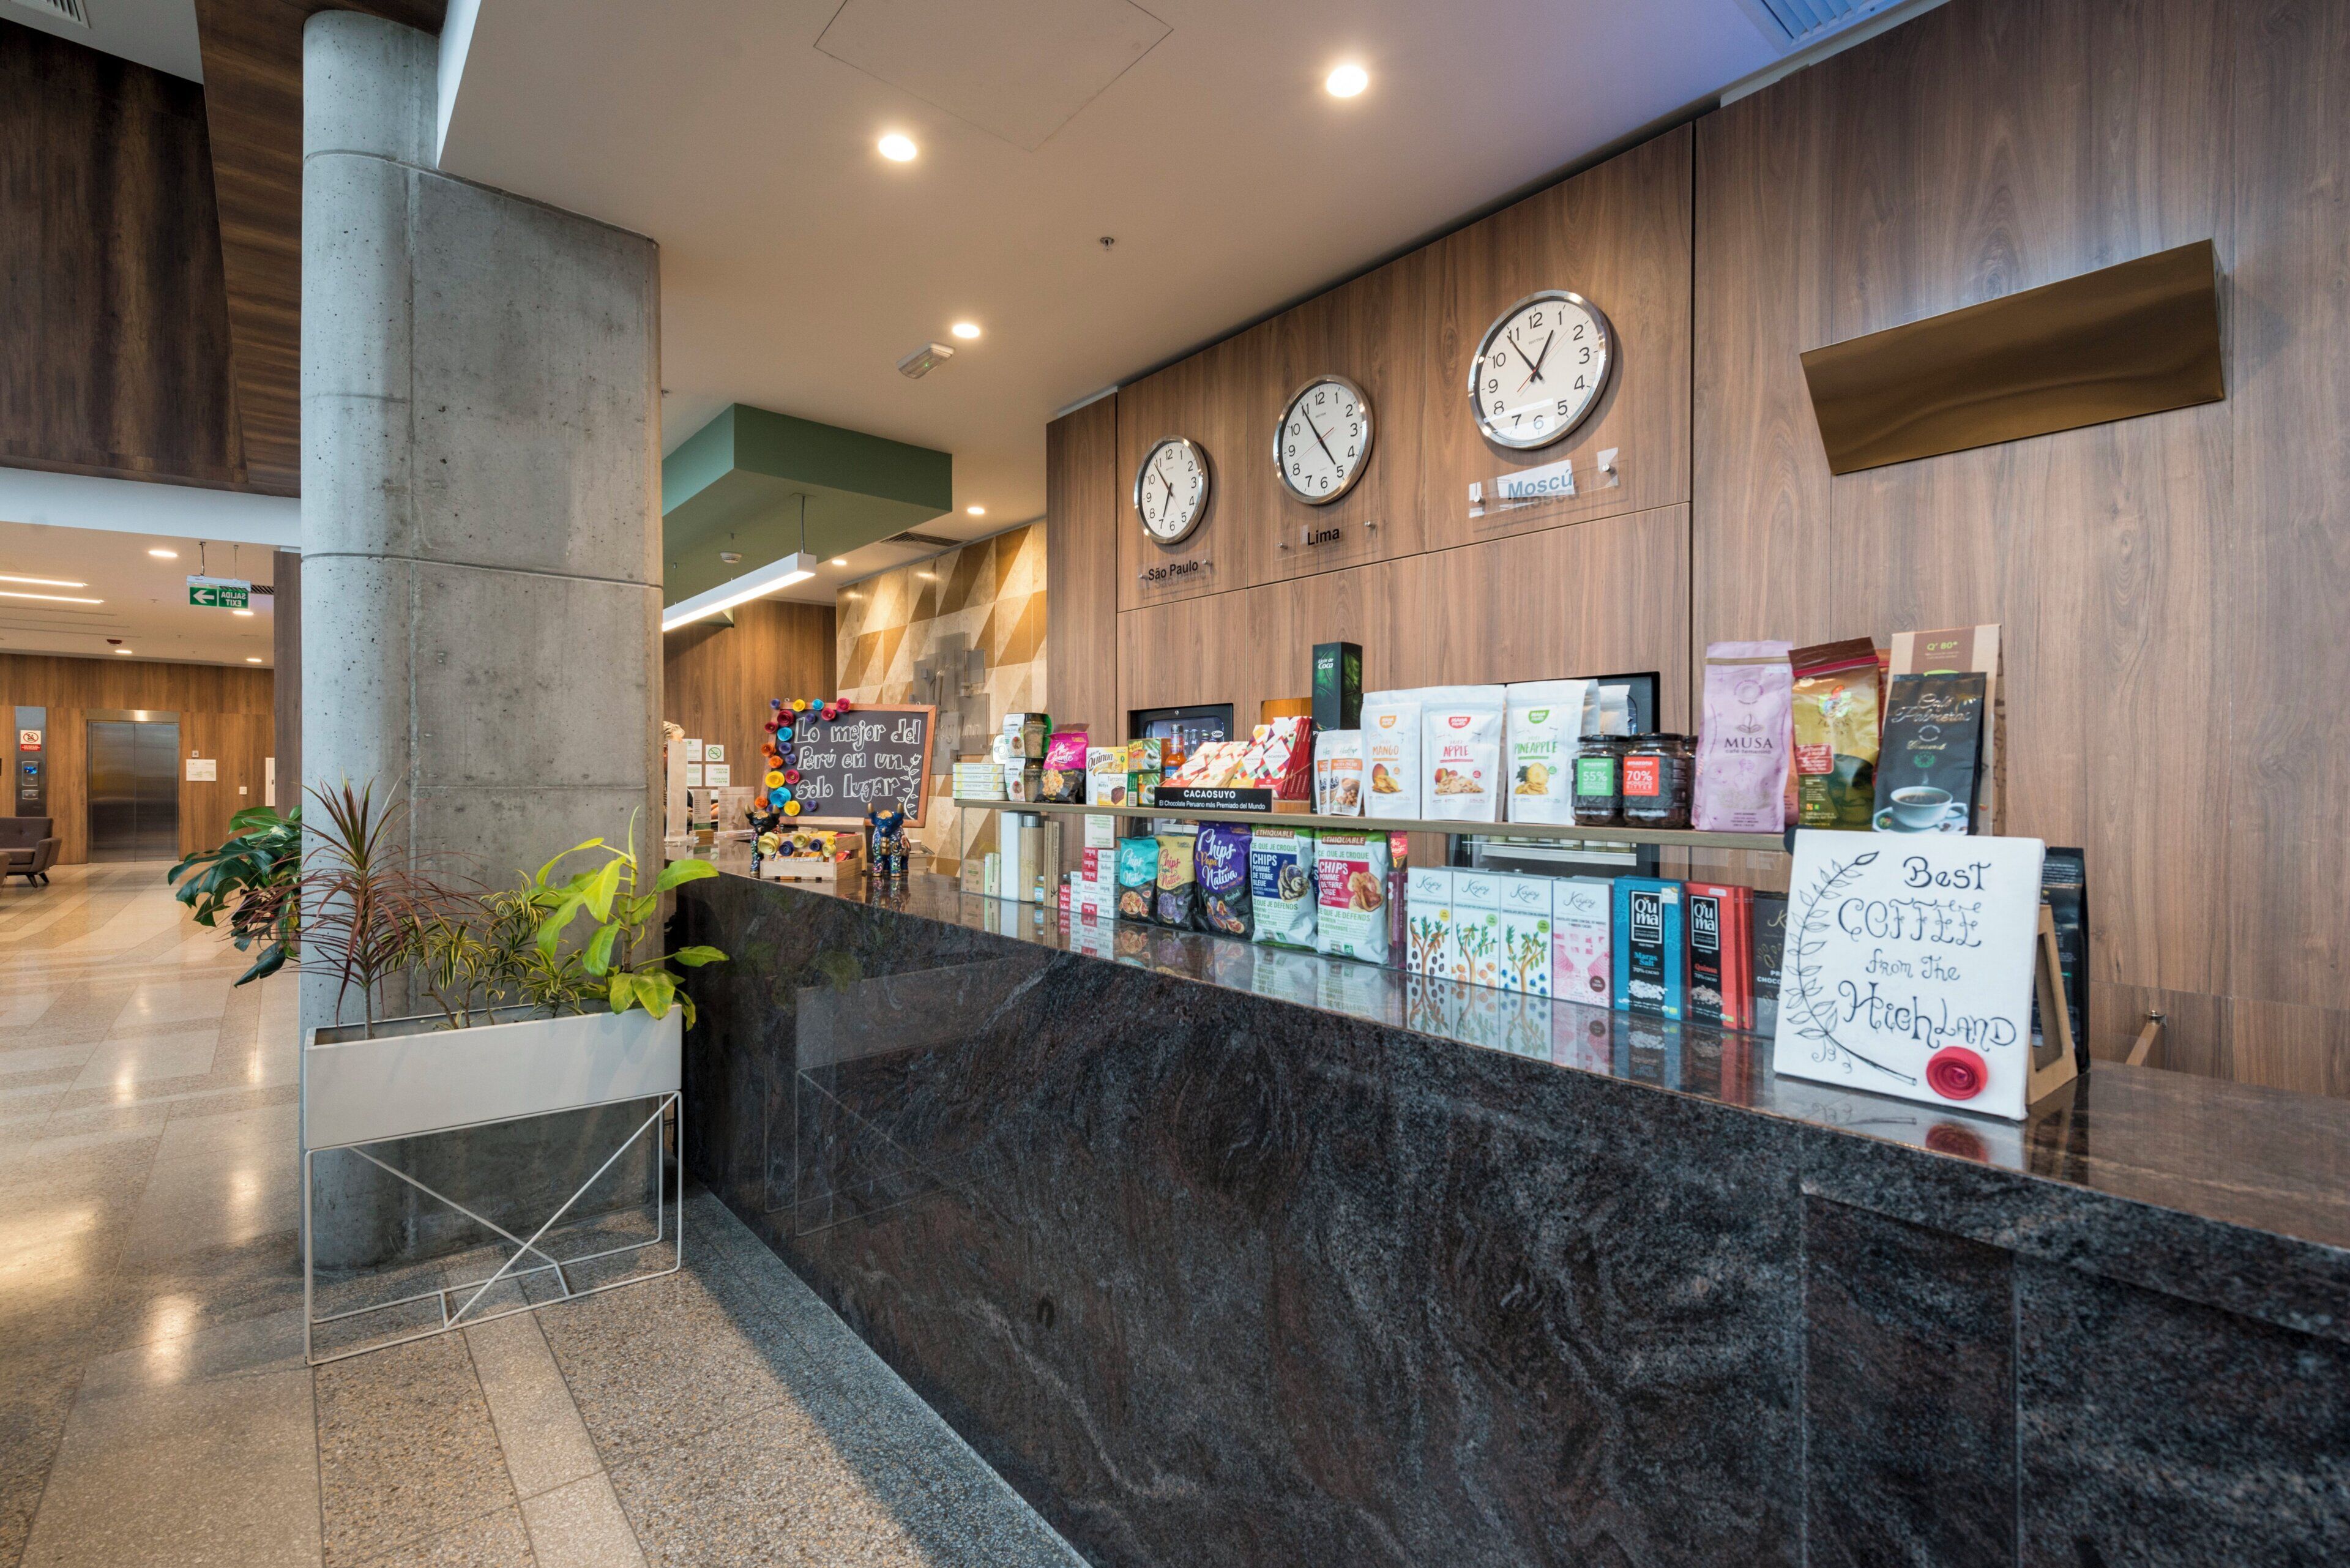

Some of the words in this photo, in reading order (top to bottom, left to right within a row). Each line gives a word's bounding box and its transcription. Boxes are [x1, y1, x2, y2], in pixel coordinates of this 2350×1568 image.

[1529, 312, 1542, 329] 12
[1559, 311, 1562, 325] 1
[1509, 327, 1519, 342] 11
[1573, 324, 1583, 341] 2
[1493, 353, 1506, 368] 10
[1579, 347, 1590, 364] 3
[1488, 379, 1498, 393] 9
[1574, 375, 1584, 390] 4
[1315, 392, 1325, 405] 12
[1335, 392, 1338, 403] 1
[1302, 403, 1309, 416] 11
[1346, 404, 1353, 417] 2
[1494, 401, 1504, 415] 8
[1558, 400, 1567, 416] 5
[1512, 414, 1521, 429] 7
[1534, 415, 1543, 430] 6
[1291, 424, 1300, 436] 10
[1350, 423, 1357, 436] 3
[1166, 449, 1173, 460] 12
[1180, 450, 1182, 459] 1
[1288, 445, 1295, 456] 9
[1348, 446, 1355, 458] 4
[1155, 458, 1162, 467] 11
[1188, 461, 1193, 471] 2
[1293, 463, 1300, 476] 8
[1337, 465, 1344, 478] 5
[1148, 474, 1155, 485] 10
[1191, 477, 1196, 488] 3
[1305, 475, 1312, 487] 7
[1321, 477, 1327, 488] 6
[1508, 469, 1572, 500] Moscú
[1146, 493, 1152, 502] 9
[1189, 496, 1195, 506] 4
[1149, 509, 1155, 518] 8
[1181, 512, 1187, 523] 5
[1159, 519, 1163, 529] 7
[1169, 521, 1175, 531] 6
[1308, 528, 1340, 545] Lima
[1149, 567, 1166, 580] São
[1169, 560, 1198, 576] Paulo
[794, 717, 819, 743] Lo
[831, 720, 886, 751] mejor
[890, 719, 921, 744] del
[1514, 741, 1558, 754] PINEAPPLE
[1724, 737, 1773, 749] MUSA
[1372, 745, 1399, 755] MANGO
[1443, 745, 1469, 756] APPLE
[797, 746, 836, 770] Perú
[841, 753, 866, 767] en
[875, 753, 903, 769] un
[1088, 753, 1113, 771] Quinua
[1583, 771, 1607, 782] 55%
[1627, 771, 1652, 781] 70%
[843, 774, 900, 802] lugar
[1184, 790, 1236, 798] CACAOSUYO
[1198, 829, 1236, 868] Chips
[1122, 848, 1144, 867] Chips
[1158, 849, 1181, 873] Chips
[1196, 851, 1218, 869] Papa
[1253, 853, 1277, 866] CHIPS
[1319, 862, 1348, 875] CHIPS
[1159, 870, 1181, 887] Nativa
[1202, 865, 1237, 890] Nativa
[1275, 901, 1298, 910] DÉFENDS
[1342, 911, 1371, 921] DÉFENDS
[1636, 913, 1658, 926] ma
[1838, 897, 1982, 947] COFFEE
[1695, 919, 1714, 931] ma
[1634, 952, 1658, 961] Maras
[1921, 955, 1960, 981] The
